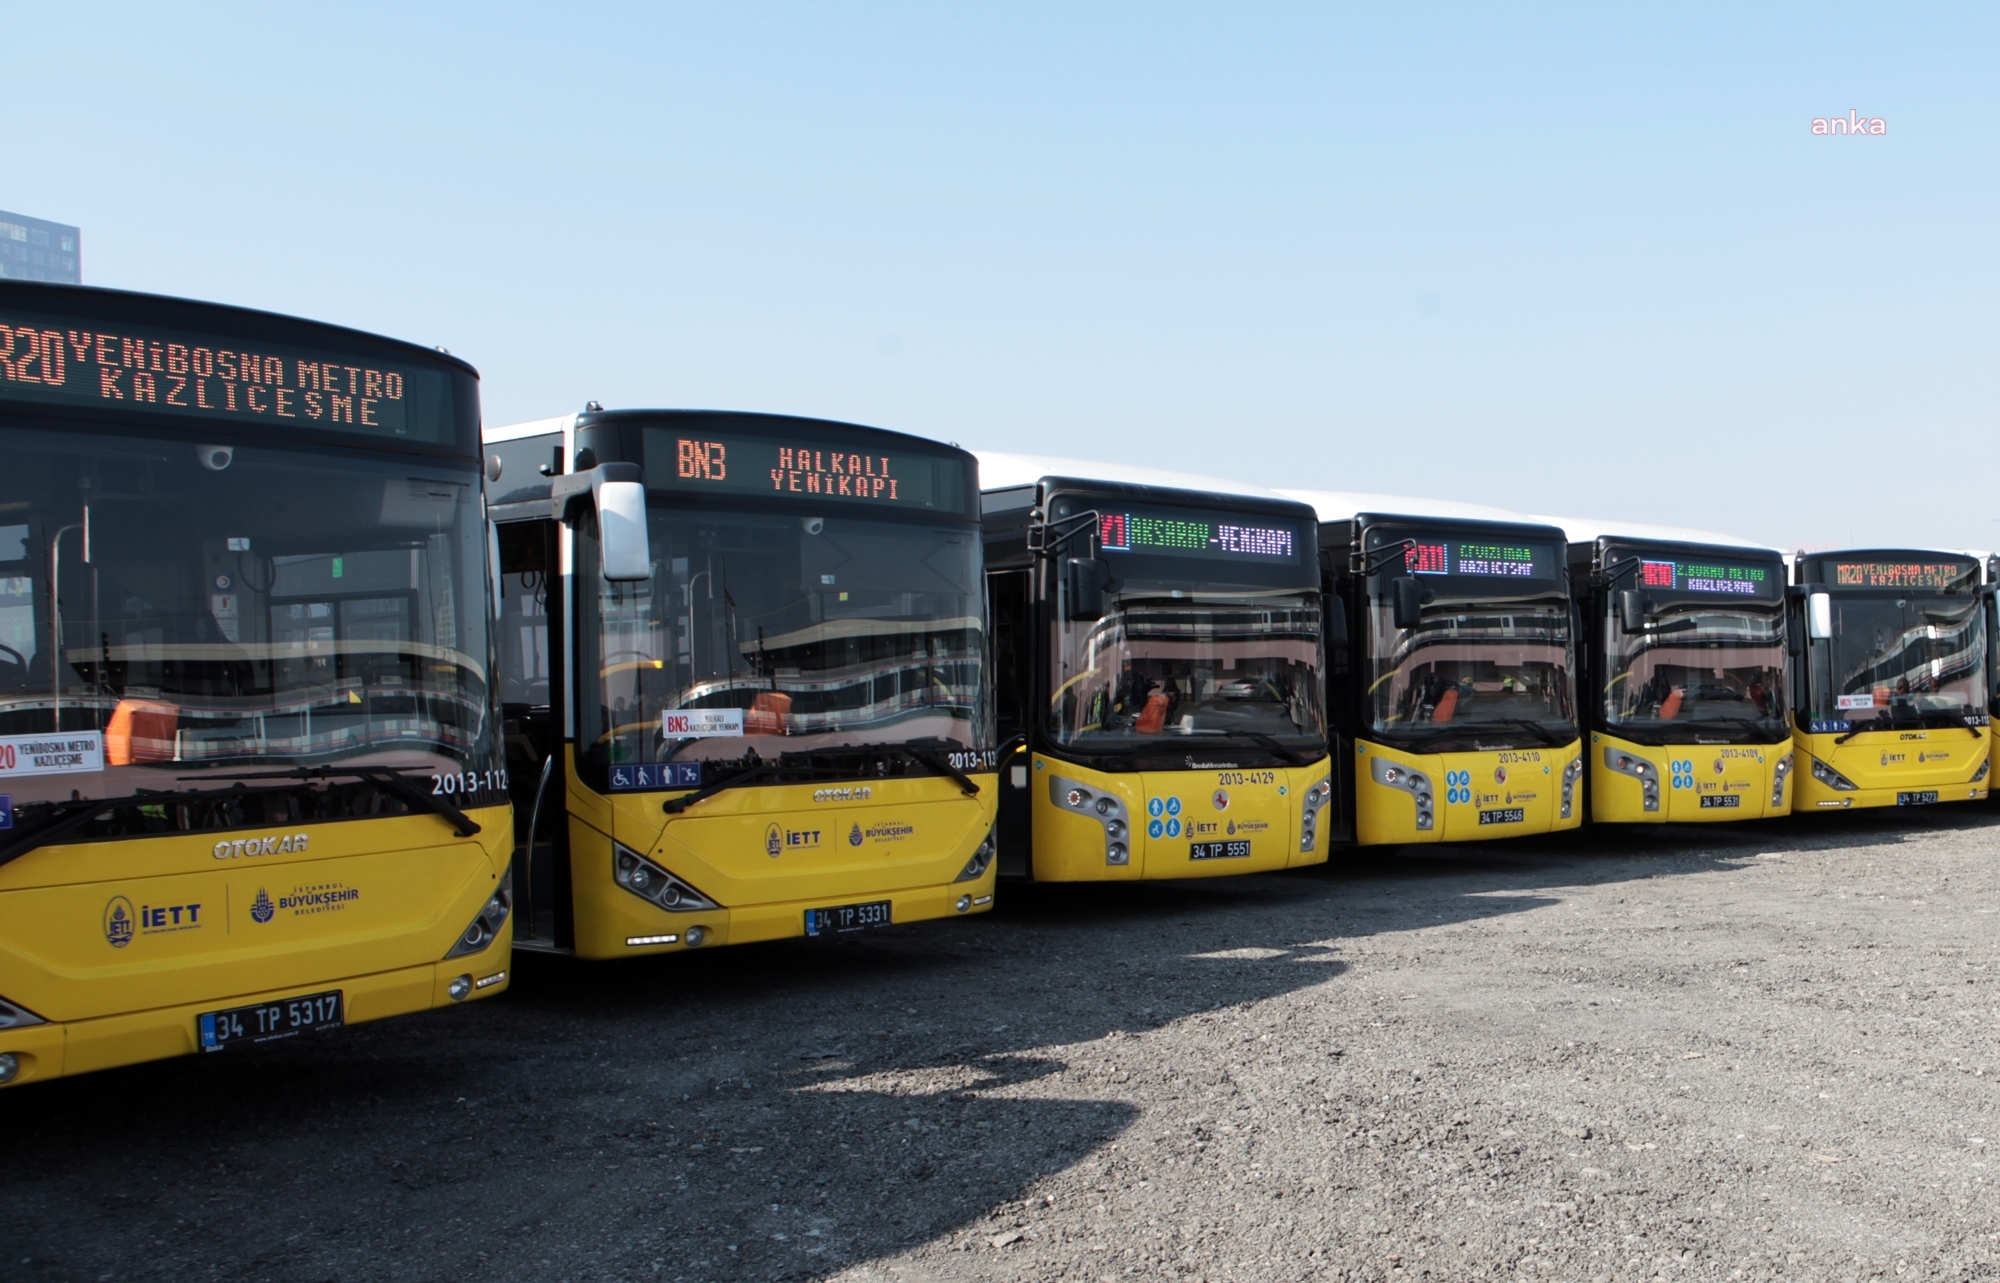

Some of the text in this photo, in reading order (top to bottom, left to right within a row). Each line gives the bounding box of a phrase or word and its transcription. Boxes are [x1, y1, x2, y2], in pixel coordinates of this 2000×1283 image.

[298, 359, 404, 400] METRO
[677, 438, 726, 481] BN3
[779, 446, 890, 478] HALKALI
[1924, 564, 1957, 577] METRO
[667, 715, 689, 733] BN3
[67, 739, 95, 753] METRO
[1498, 751, 1541, 764] 2013-4110
[1720, 748, 1758, 759] 2013-4109
[1889, 752, 1906, 761] İETT
[1218, 771, 1274, 786] 2013-4129
[813, 786, 871, 803] OTOKAR
[1483, 794, 1499, 803] İETT
[1702, 797, 1711, 807] 34
[1713, 796, 1722, 806] TP
[1912, 793, 1920, 802] TP
[1481, 809, 1523, 823] 34 TP 5546
[865, 824, 914, 837] BÜYÜKŞEHİR
[1196, 821, 1218, 832] İETT
[787, 830, 821, 846] İETT
[213, 833, 309, 860] OTOKAR
[1193, 841, 1249, 858] 34 TP 5551
[294, 882, 344, 894] İSTANBUL
[279, 887, 359, 910] BÜYÜKŞEHİR
[142, 903, 202, 929] İETT
[295, 903, 345, 916] BELEDİYESİ
[815, 904, 887, 928] 34 TP 5331
[216, 995, 337, 1040] 34 TP 5317
